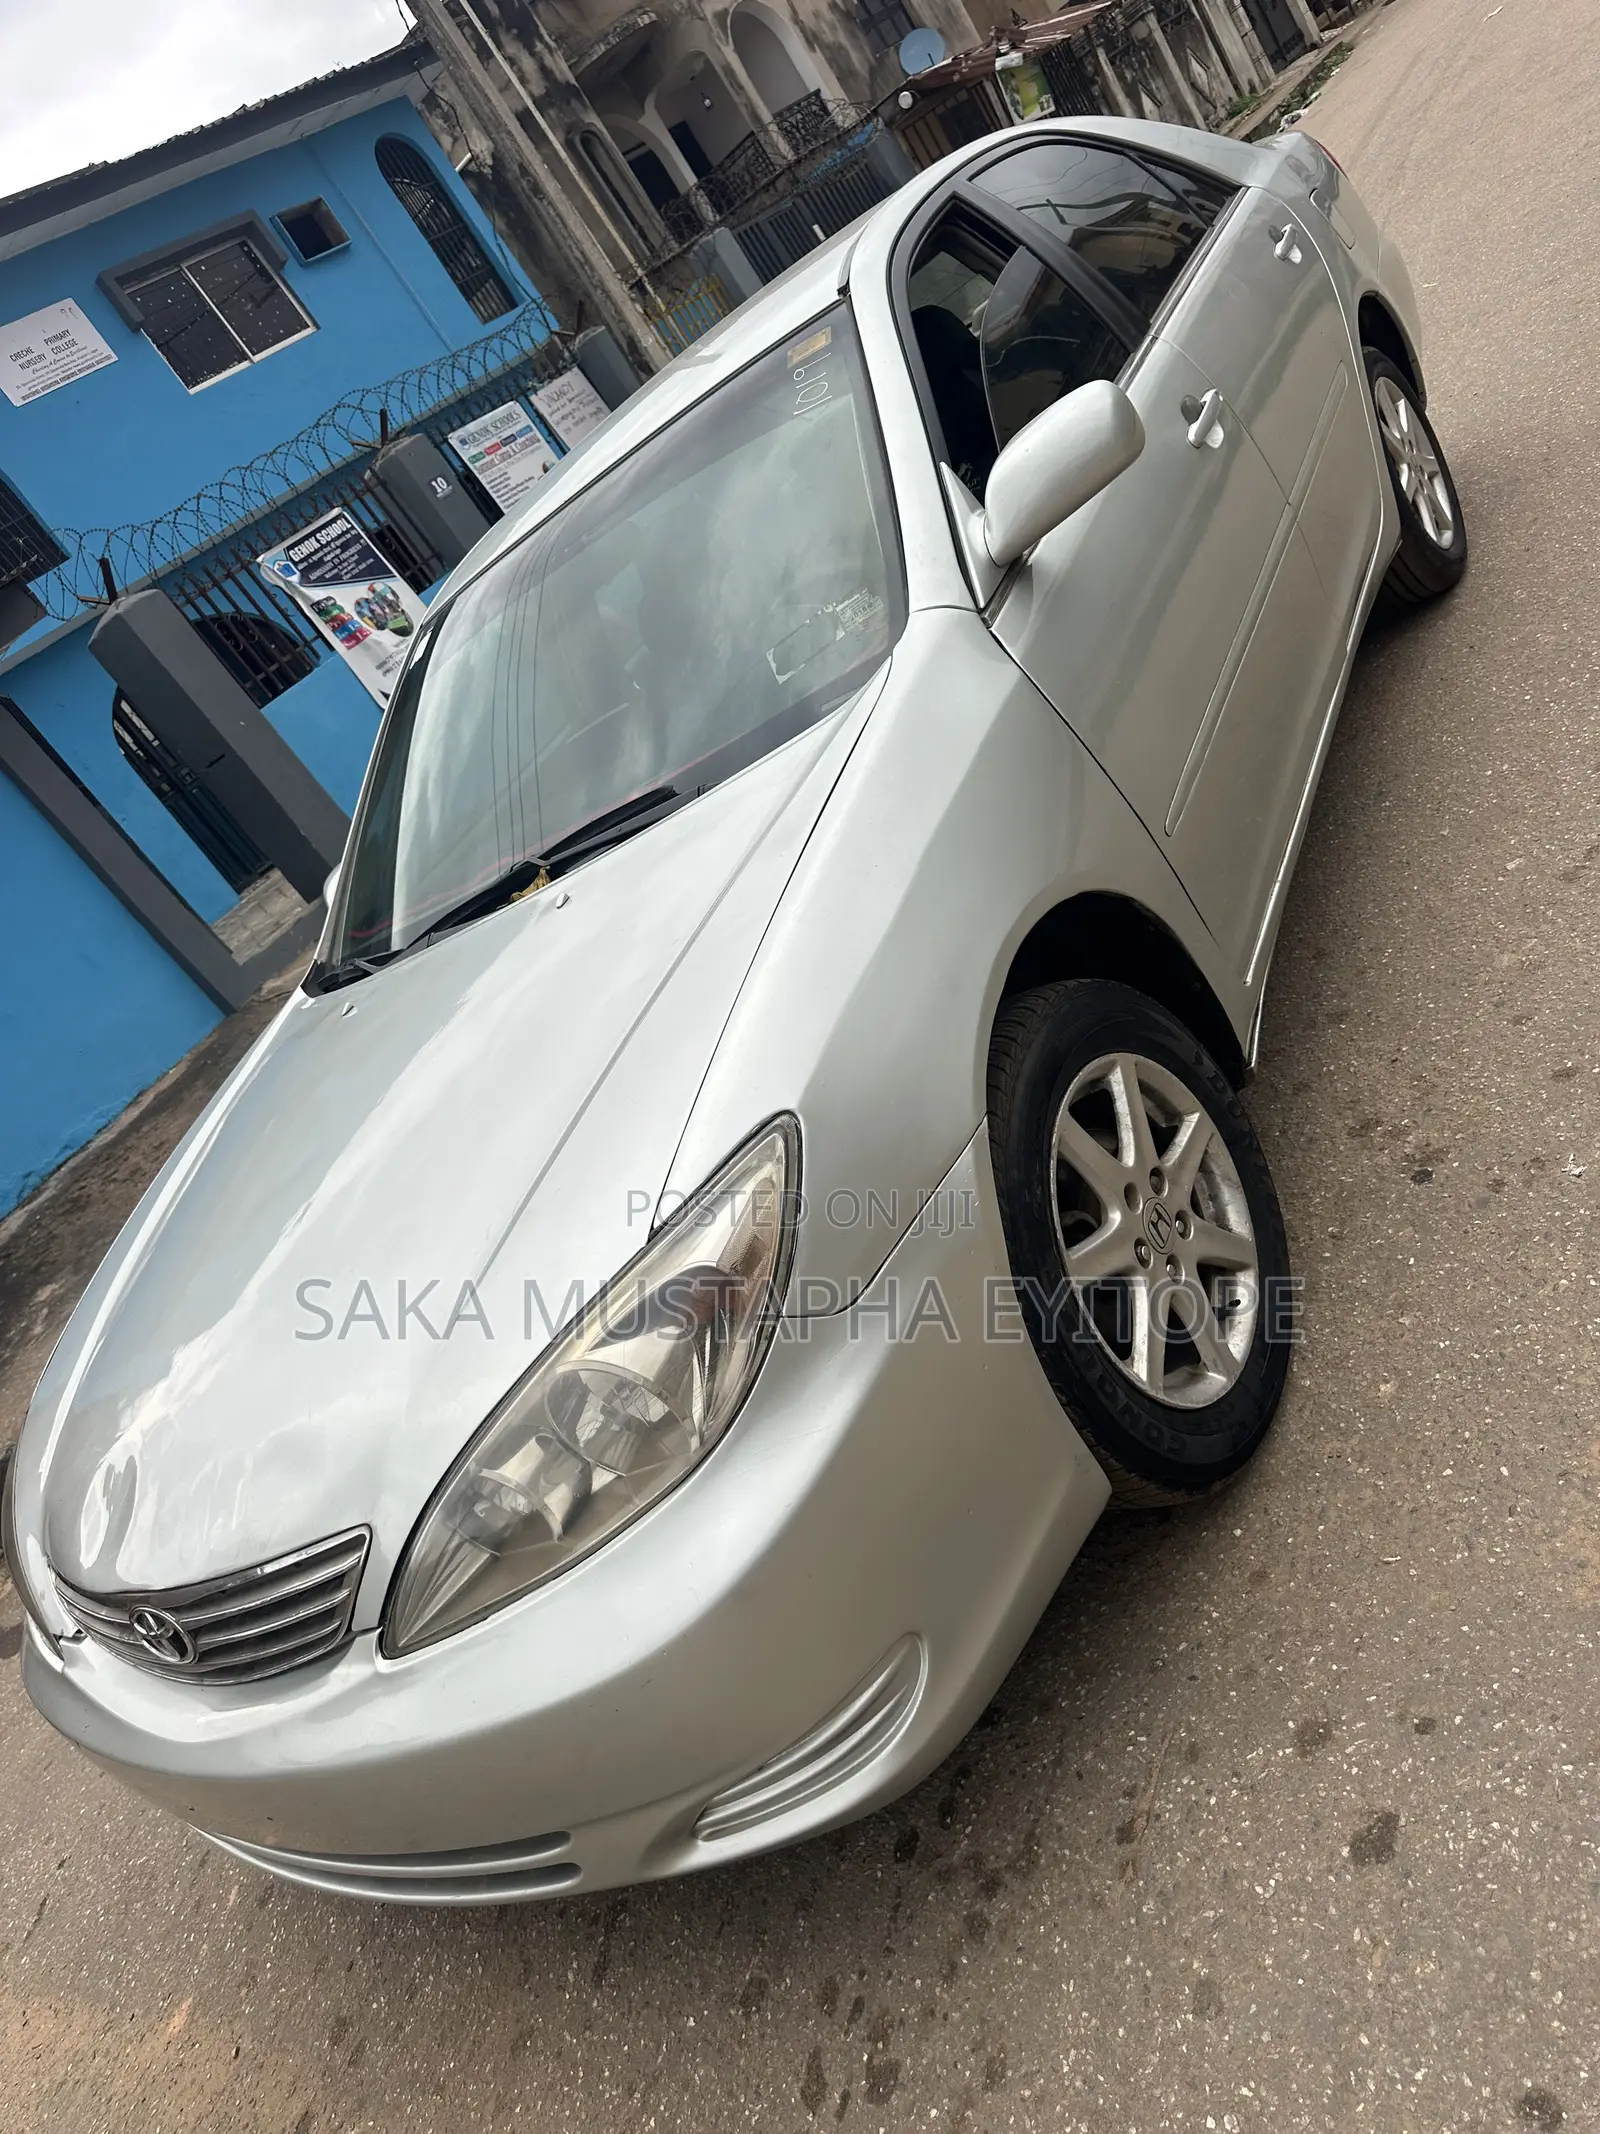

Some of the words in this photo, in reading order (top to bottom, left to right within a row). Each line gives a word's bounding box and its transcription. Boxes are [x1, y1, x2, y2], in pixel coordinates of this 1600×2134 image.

[10, 347, 35, 362] CRECHE
[44, 329, 72, 346] PRIMARY
[19, 353, 47, 371] NURSERY
[51, 338, 78, 355] COLLEGE
[431, 477, 448, 493] 10
[289, 536, 320, 562] GENOK
[316, 518, 351, 545] SCHOOL
